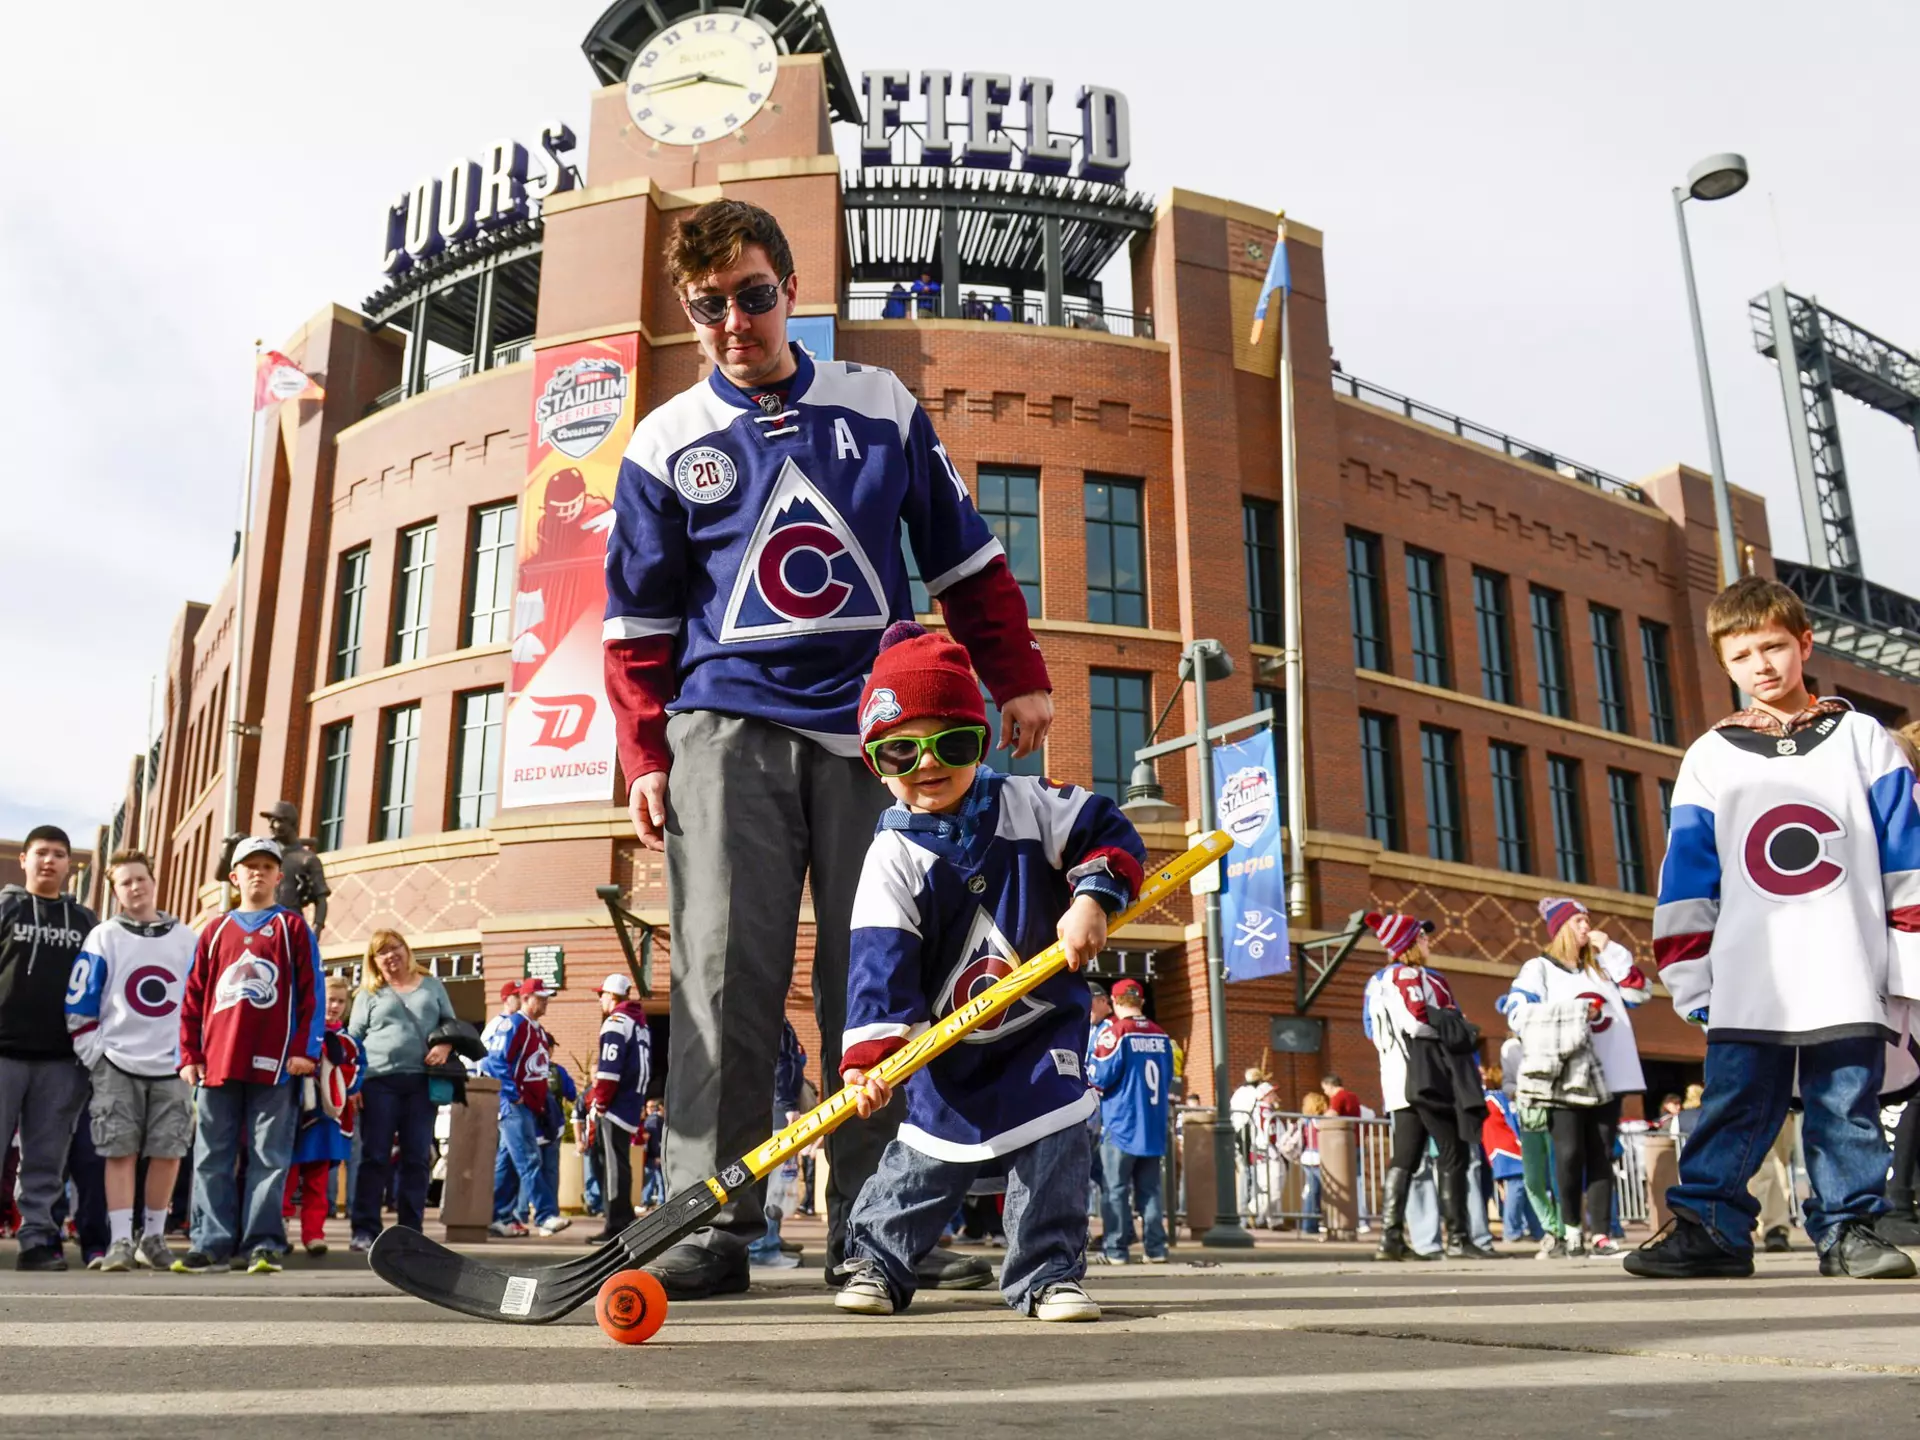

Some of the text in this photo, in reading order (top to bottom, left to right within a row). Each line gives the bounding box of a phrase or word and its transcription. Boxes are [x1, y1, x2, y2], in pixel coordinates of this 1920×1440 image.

[694, 19, 716, 33] 12
[731, 20, 740, 33] 1
[662, 30, 682, 46] 11
[750, 36, 766, 50] 2
[639, 51, 659, 69] 10
[758, 61, 772, 74] 3
[631, 83, 646, 95] 9
[748, 92, 762, 105] 4
[637, 108, 653, 121] 8
[724, 113, 739, 127] 5
[660, 124, 676, 136] 7
[692, 126, 705, 140] 6
[381, 69, 1131, 274] COORS FIELD
[538, 377, 627, 420] STADIUM
[555, 402, 612, 426] SERIES
[834, 417, 861, 460] A
[680, 452, 732, 492] COLORADO AVALANCHE
[692, 461, 720, 488] 20
[758, 522, 853, 621] C
[529, 693, 597, 752] D
[513, 760, 608, 782] RED WINGS
[1740, 801, 1847, 903] C
[13, 921, 82, 943] umbro
[65, 958, 91, 1006] 9
[124, 965, 178, 1017] C
[944, 997, 994, 1038] NHL
[601, 1042, 619, 1061] 16
[1144, 1059, 1160, 1106] 9
